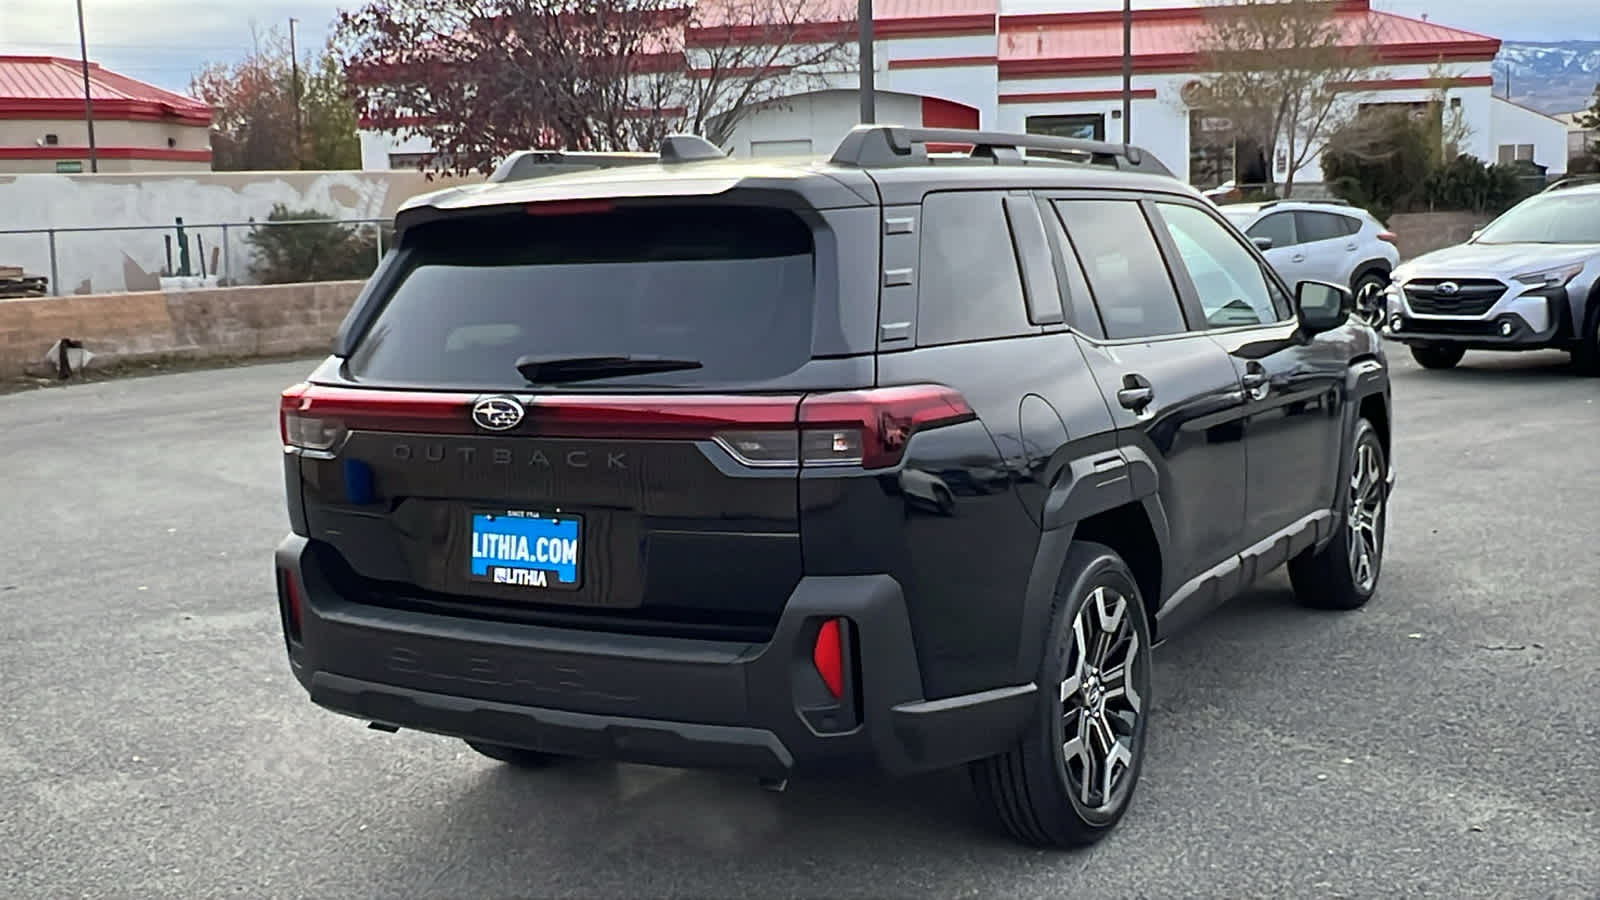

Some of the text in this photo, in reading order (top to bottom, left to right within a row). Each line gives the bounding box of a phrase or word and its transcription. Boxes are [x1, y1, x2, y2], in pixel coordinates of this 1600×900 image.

[392, 443, 628, 469] OUTBACK
[472, 531, 578, 566] LITHIA.COM
[506, 567, 548, 588] LITHIA
